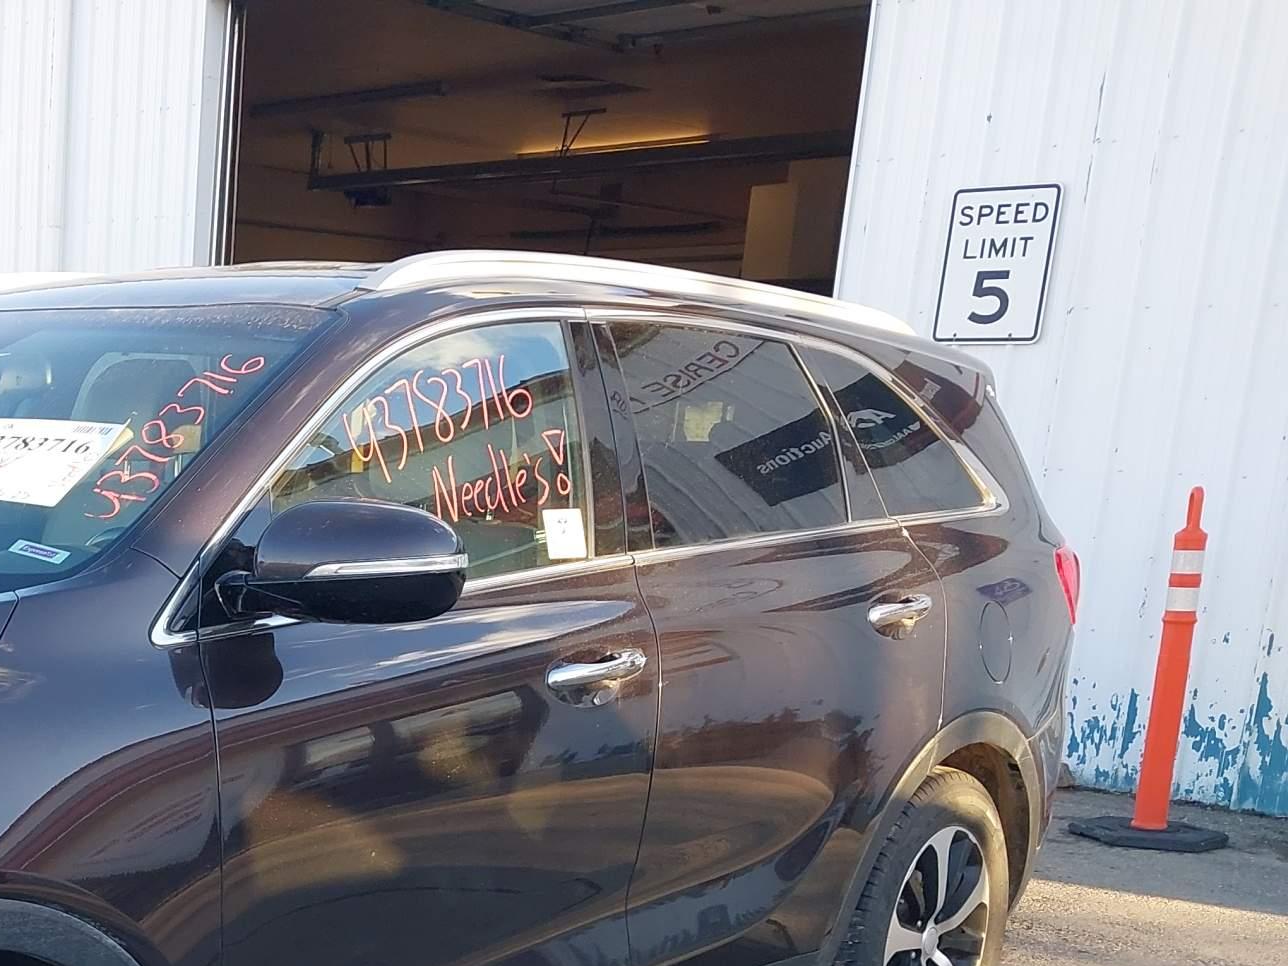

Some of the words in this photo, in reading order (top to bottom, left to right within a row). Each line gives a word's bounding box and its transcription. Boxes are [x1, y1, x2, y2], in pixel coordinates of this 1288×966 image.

[959, 202, 1049, 227] SPEED
[963, 236, 1034, 260] LIMIT
[967, 269, 1011, 325] 5
[83, 353, 266, 520] 43783716
[342, 354, 533, 484] 43783716
